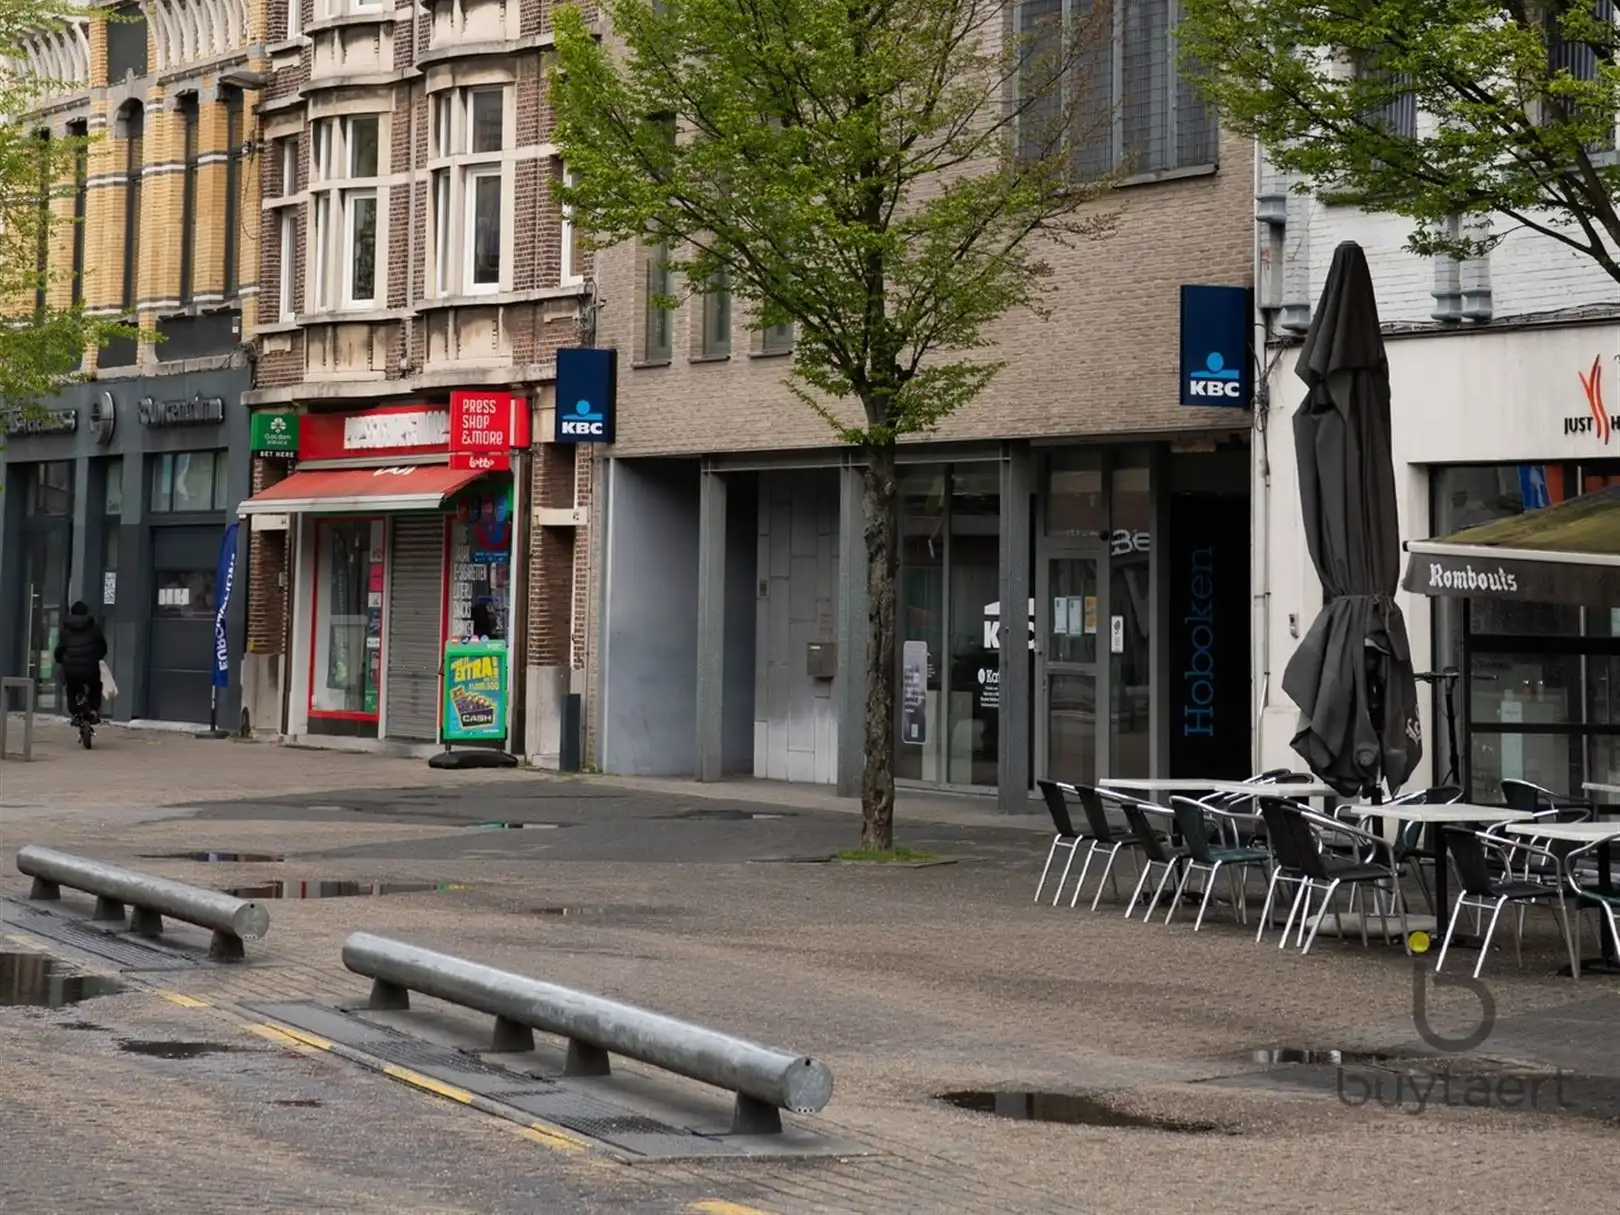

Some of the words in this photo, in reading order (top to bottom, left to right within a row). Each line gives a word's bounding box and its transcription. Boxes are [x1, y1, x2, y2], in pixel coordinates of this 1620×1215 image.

[1189, 379, 1240, 397] KBC
[462, 414, 490, 429] SHOP
[562, 421, 603, 435] KBC
[1564, 417, 1594, 435] JUST
[260, 450, 274, 458] BET
[275, 450, 295, 459] HERE
[1428, 562, 1518, 593] Rombouts
[1184, 546, 1213, 737] Hoboken
[462, 713, 492, 723] CASH
